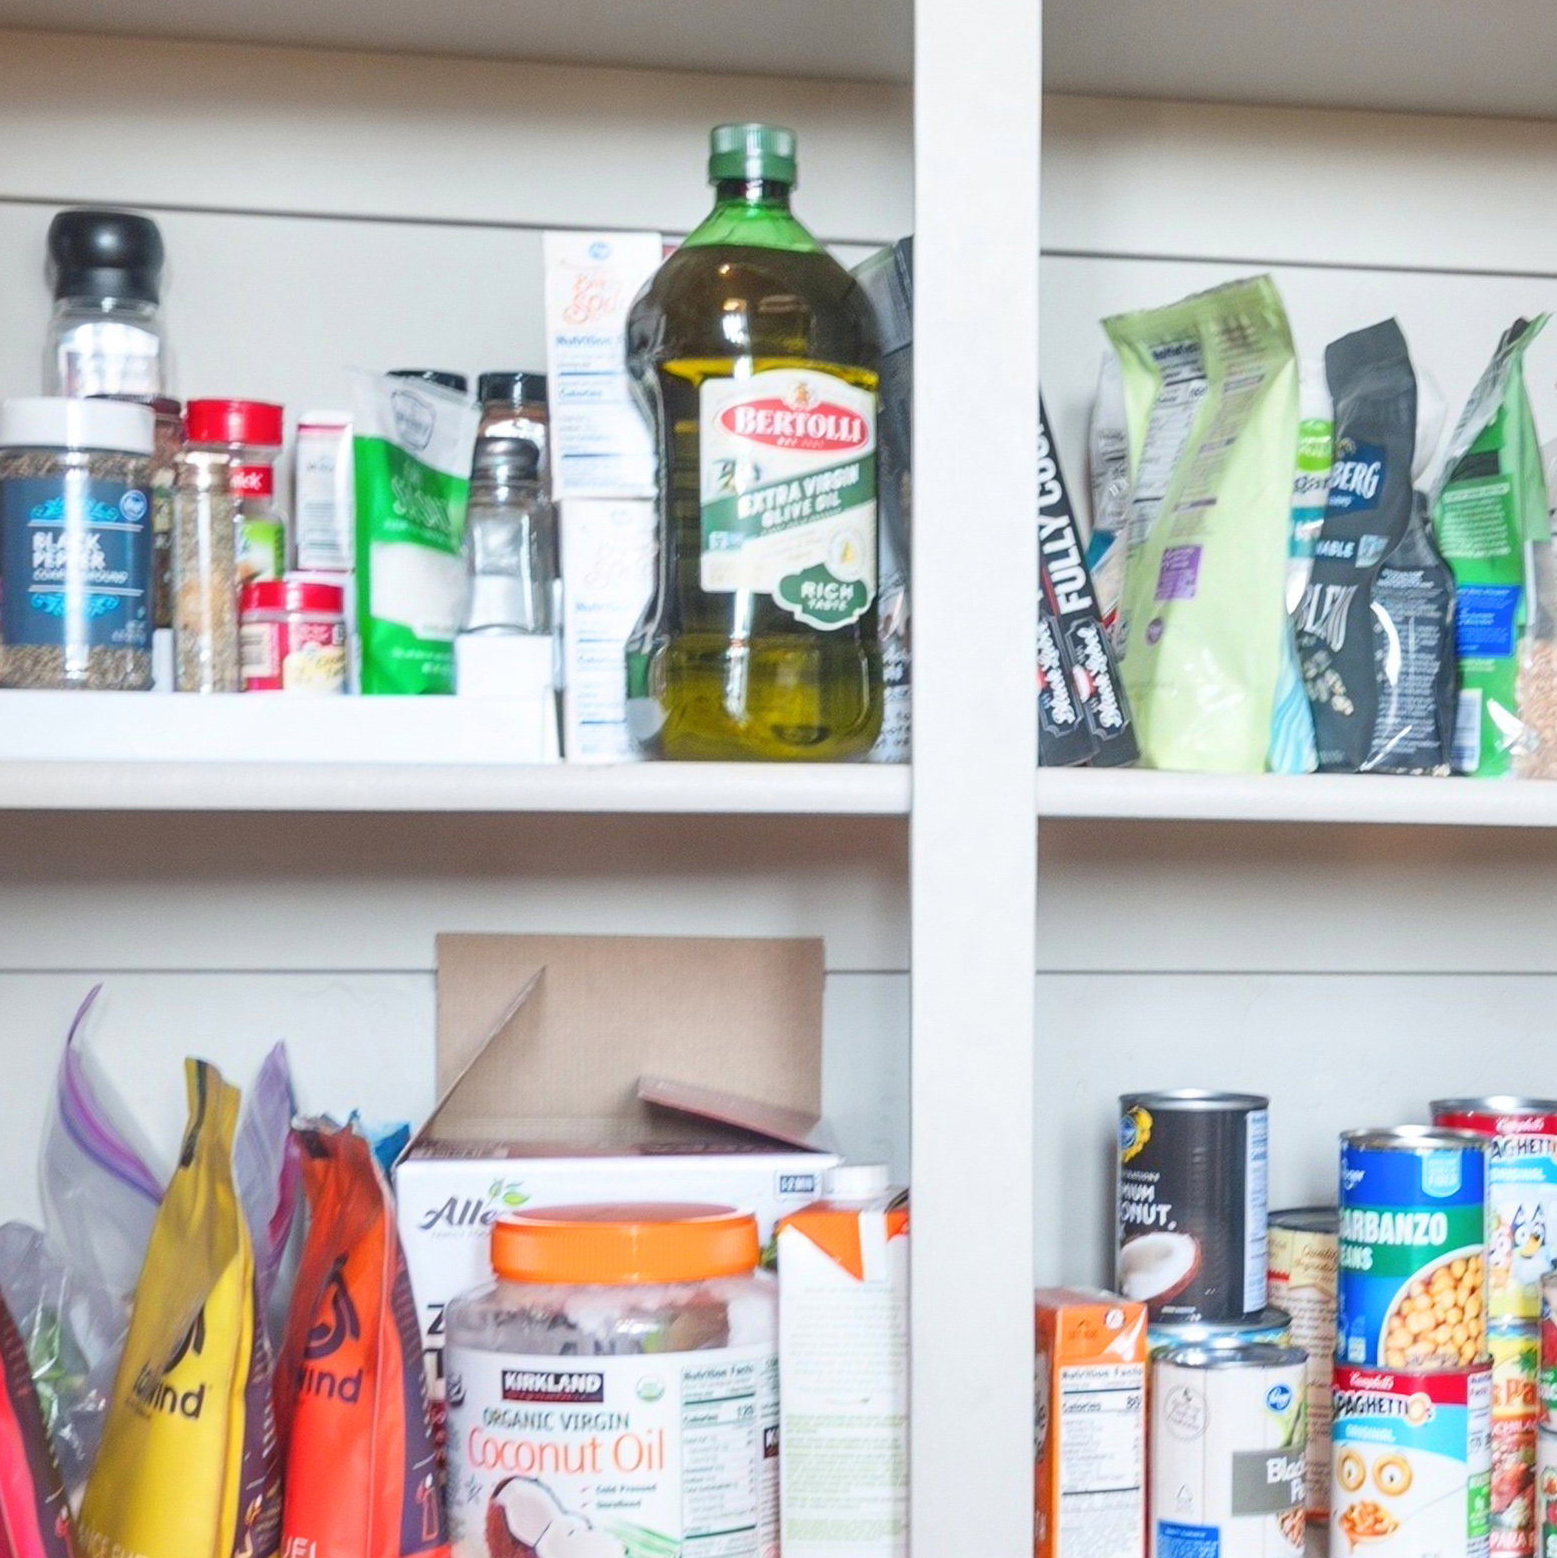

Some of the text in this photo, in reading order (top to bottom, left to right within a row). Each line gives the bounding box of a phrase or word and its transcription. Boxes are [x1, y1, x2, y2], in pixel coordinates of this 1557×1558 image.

[734, 407, 862, 443] BERTOLLI
[738, 462, 859, 520] EXTRA VIRGIN
[760, 498, 841, 528] OLIVE OIL
[1041, 515, 1093, 615] FULLY
[800, 580, 854, 602] RICH
[504, 1372, 603, 1395] KIRKLAND
[482, 1408, 630, 1432] ORGANIC VIRGIN
[466, 1427, 666, 1476] Coconut Oil
